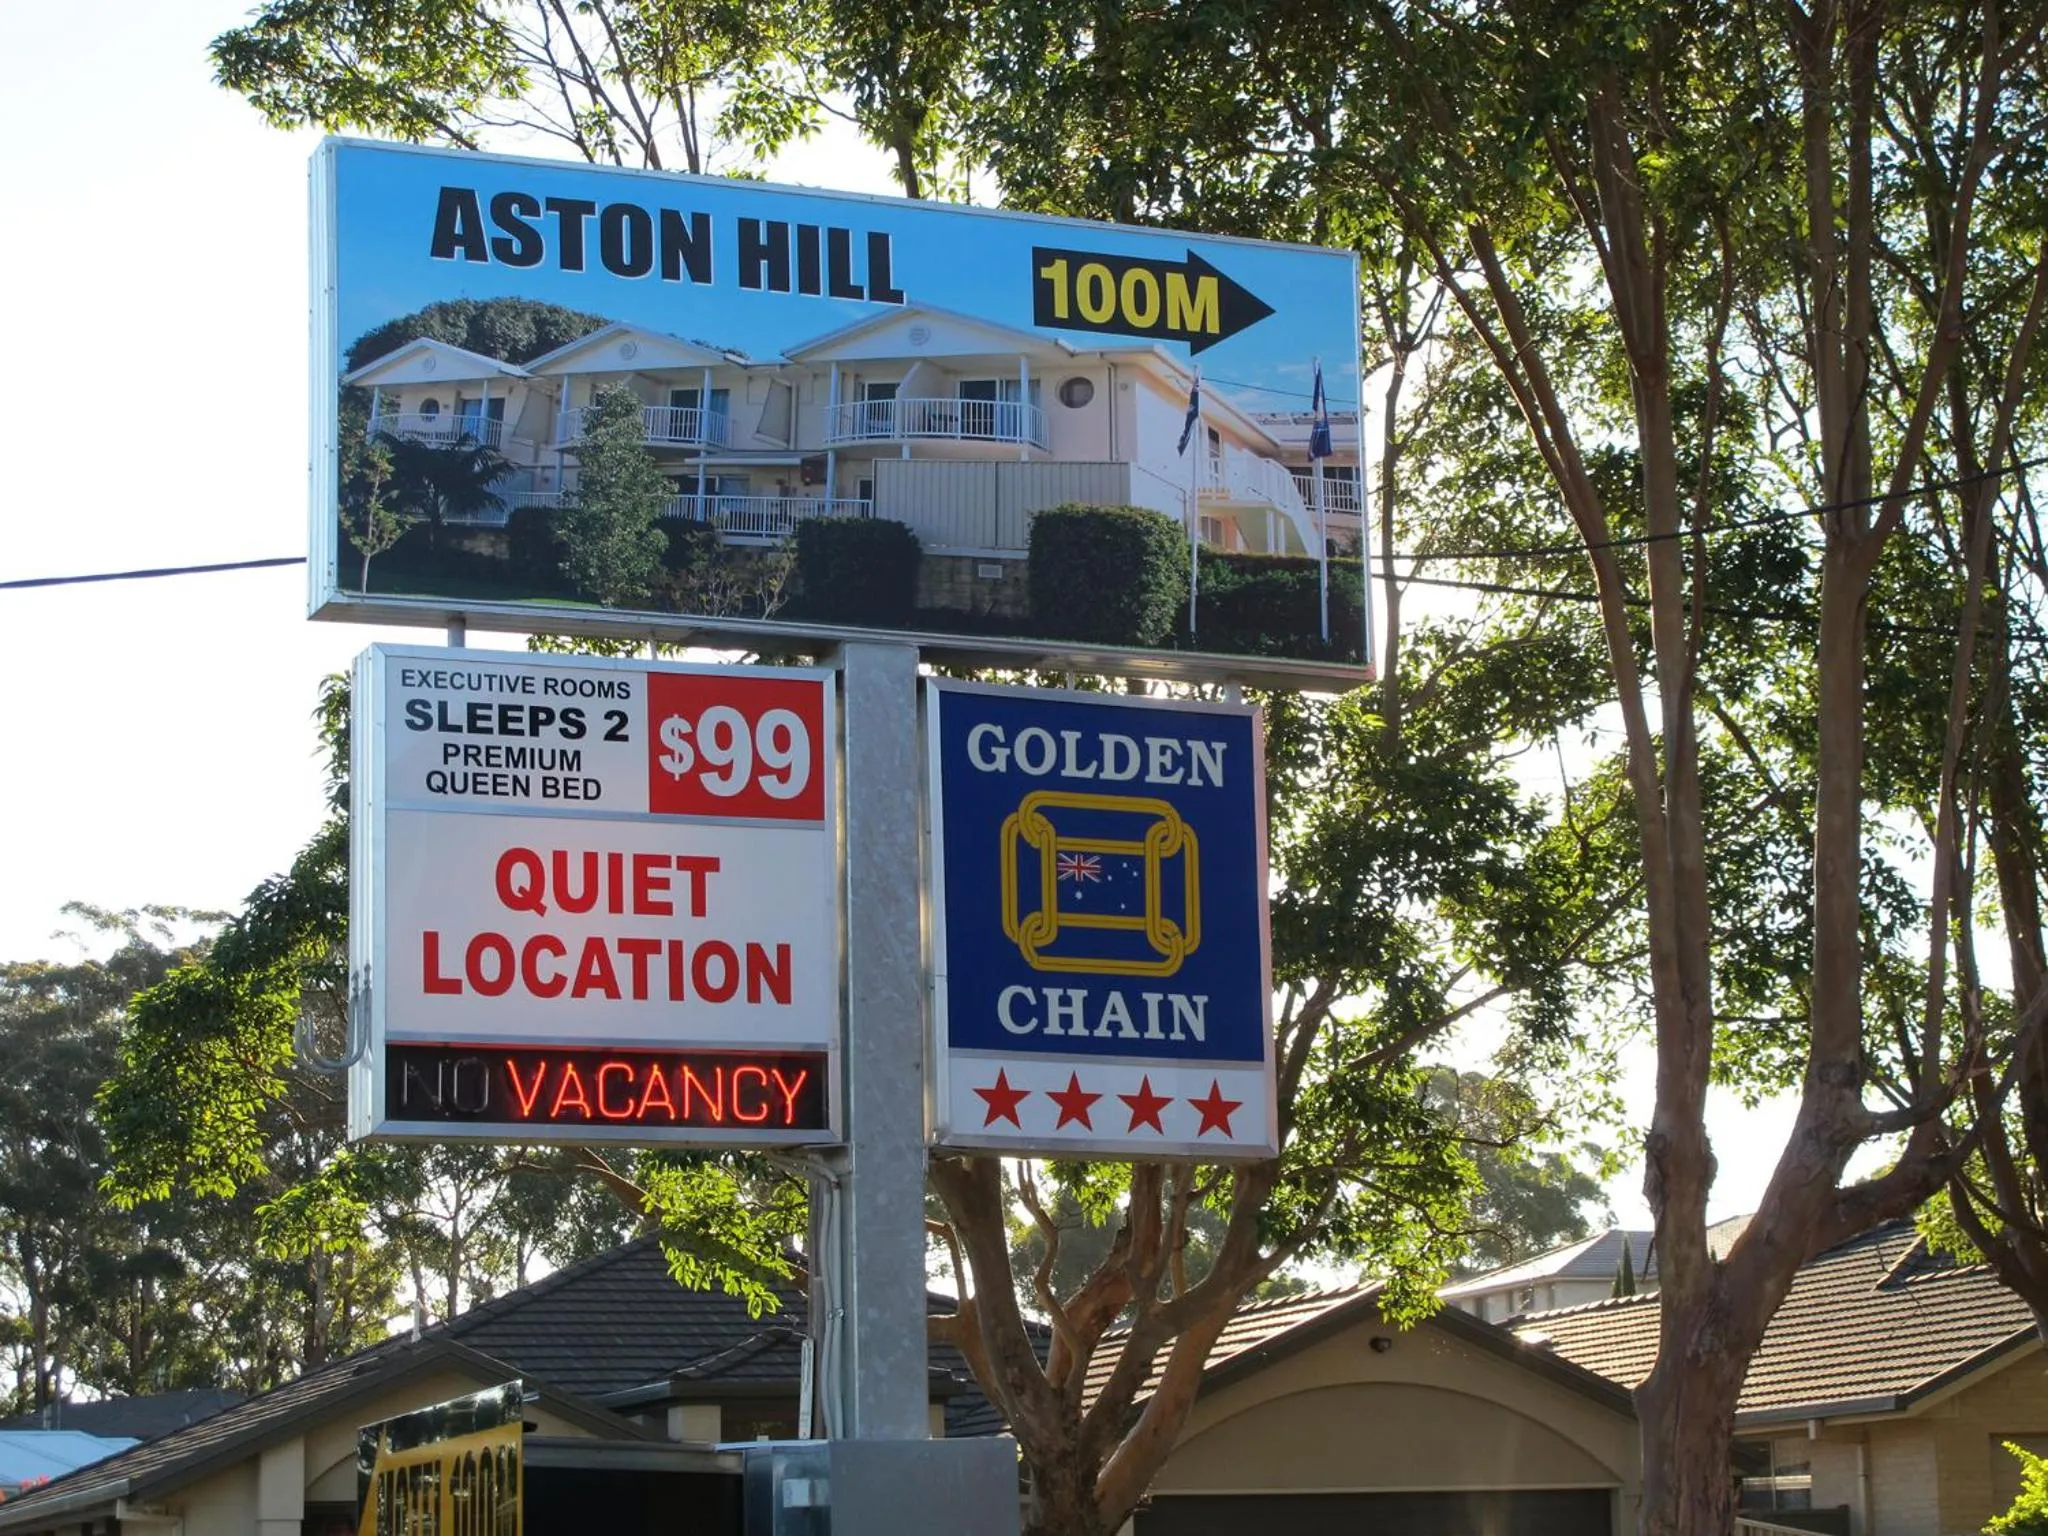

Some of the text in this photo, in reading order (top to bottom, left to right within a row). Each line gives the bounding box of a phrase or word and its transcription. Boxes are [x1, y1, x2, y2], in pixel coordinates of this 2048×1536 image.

[430, 185, 906, 306] ASTON HILL
[1040, 258, 1221, 335] 100M
[401, 669, 631, 700] EXECUTIVE ROOMS
[405, 698, 630, 743] SLEEPS 2
[659, 705, 811, 800] $99
[425, 770, 602, 801] QUEEN BED
[443, 742, 582, 773] PREMIUM
[966, 722, 1228, 788] GOLDEN
[495, 847, 721, 918] QUIET
[423, 931, 792, 1005] LOCATION
[997, 984, 1209, 1042] CHAIN
[402, 1057, 808, 1125] NO VACANCY
